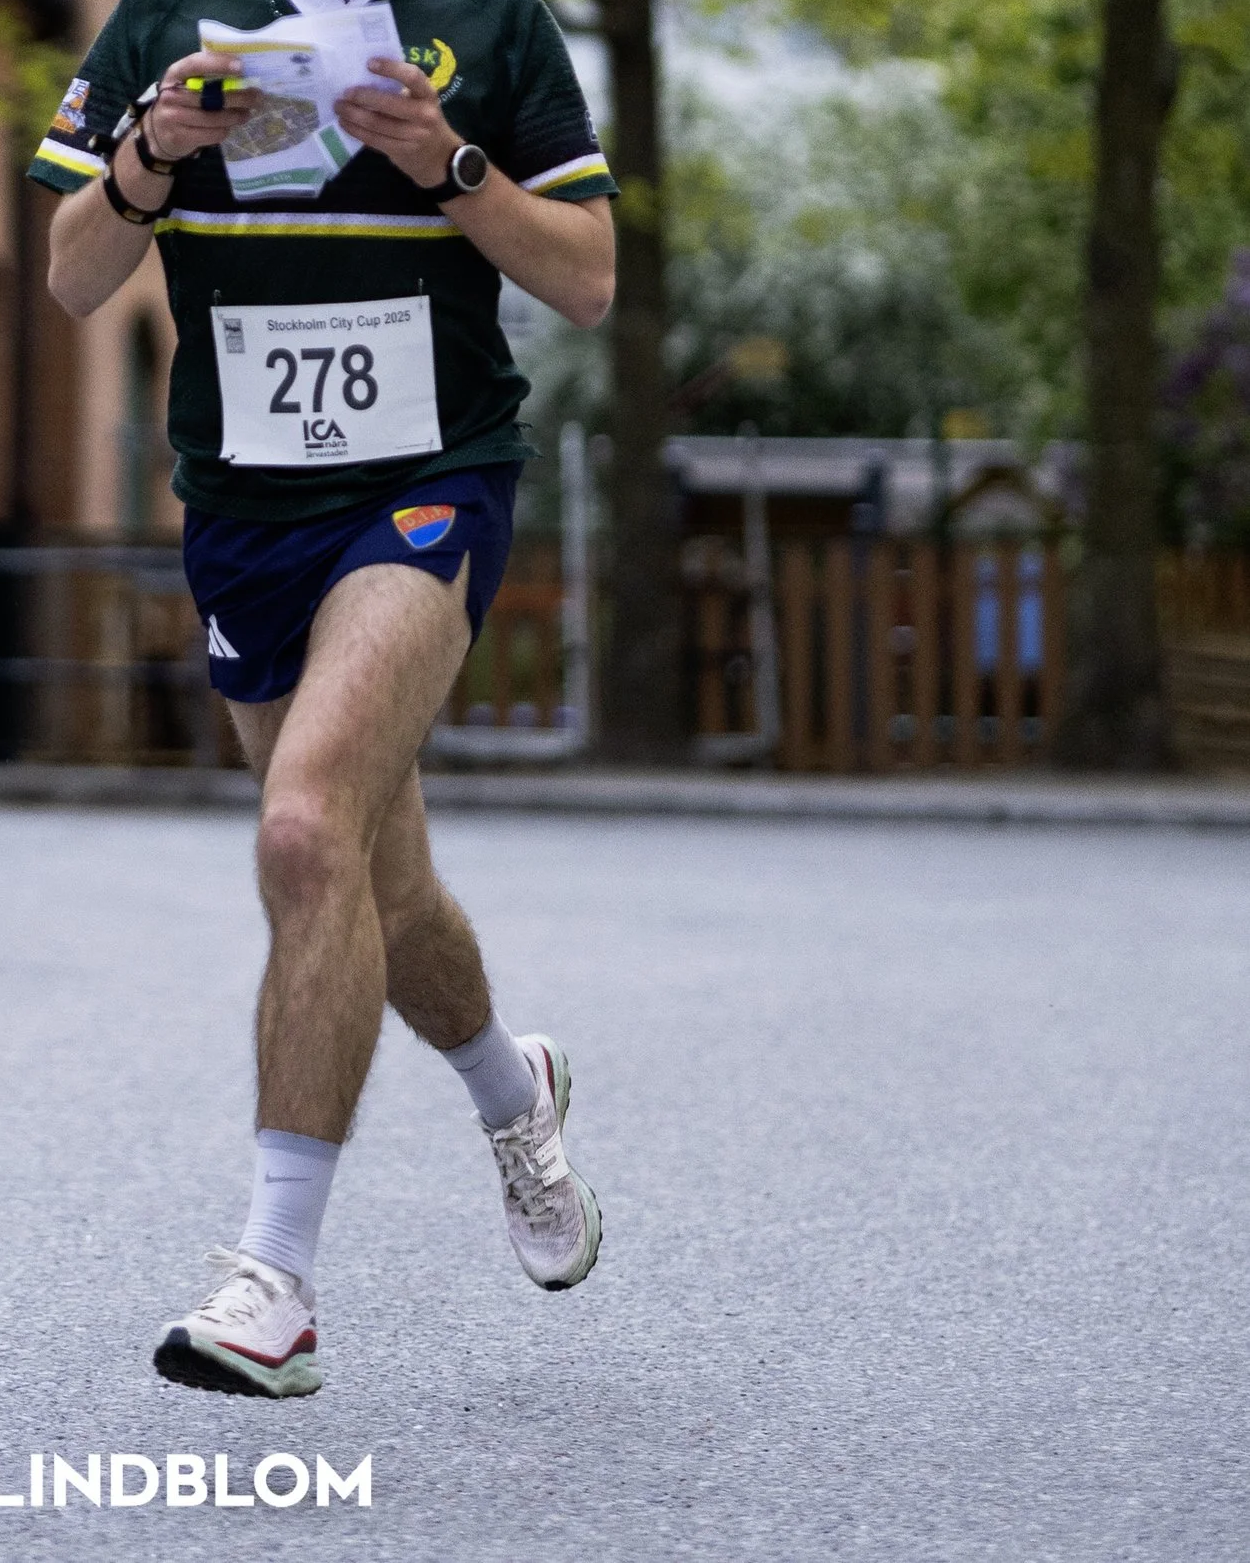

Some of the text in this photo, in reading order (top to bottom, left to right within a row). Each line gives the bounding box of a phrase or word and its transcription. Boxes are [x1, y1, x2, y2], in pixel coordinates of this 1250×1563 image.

[267, 310, 411, 331] Stockholm City Cup 2025
[266, 344, 379, 414] 278
[303, 418, 347, 441] ICA
